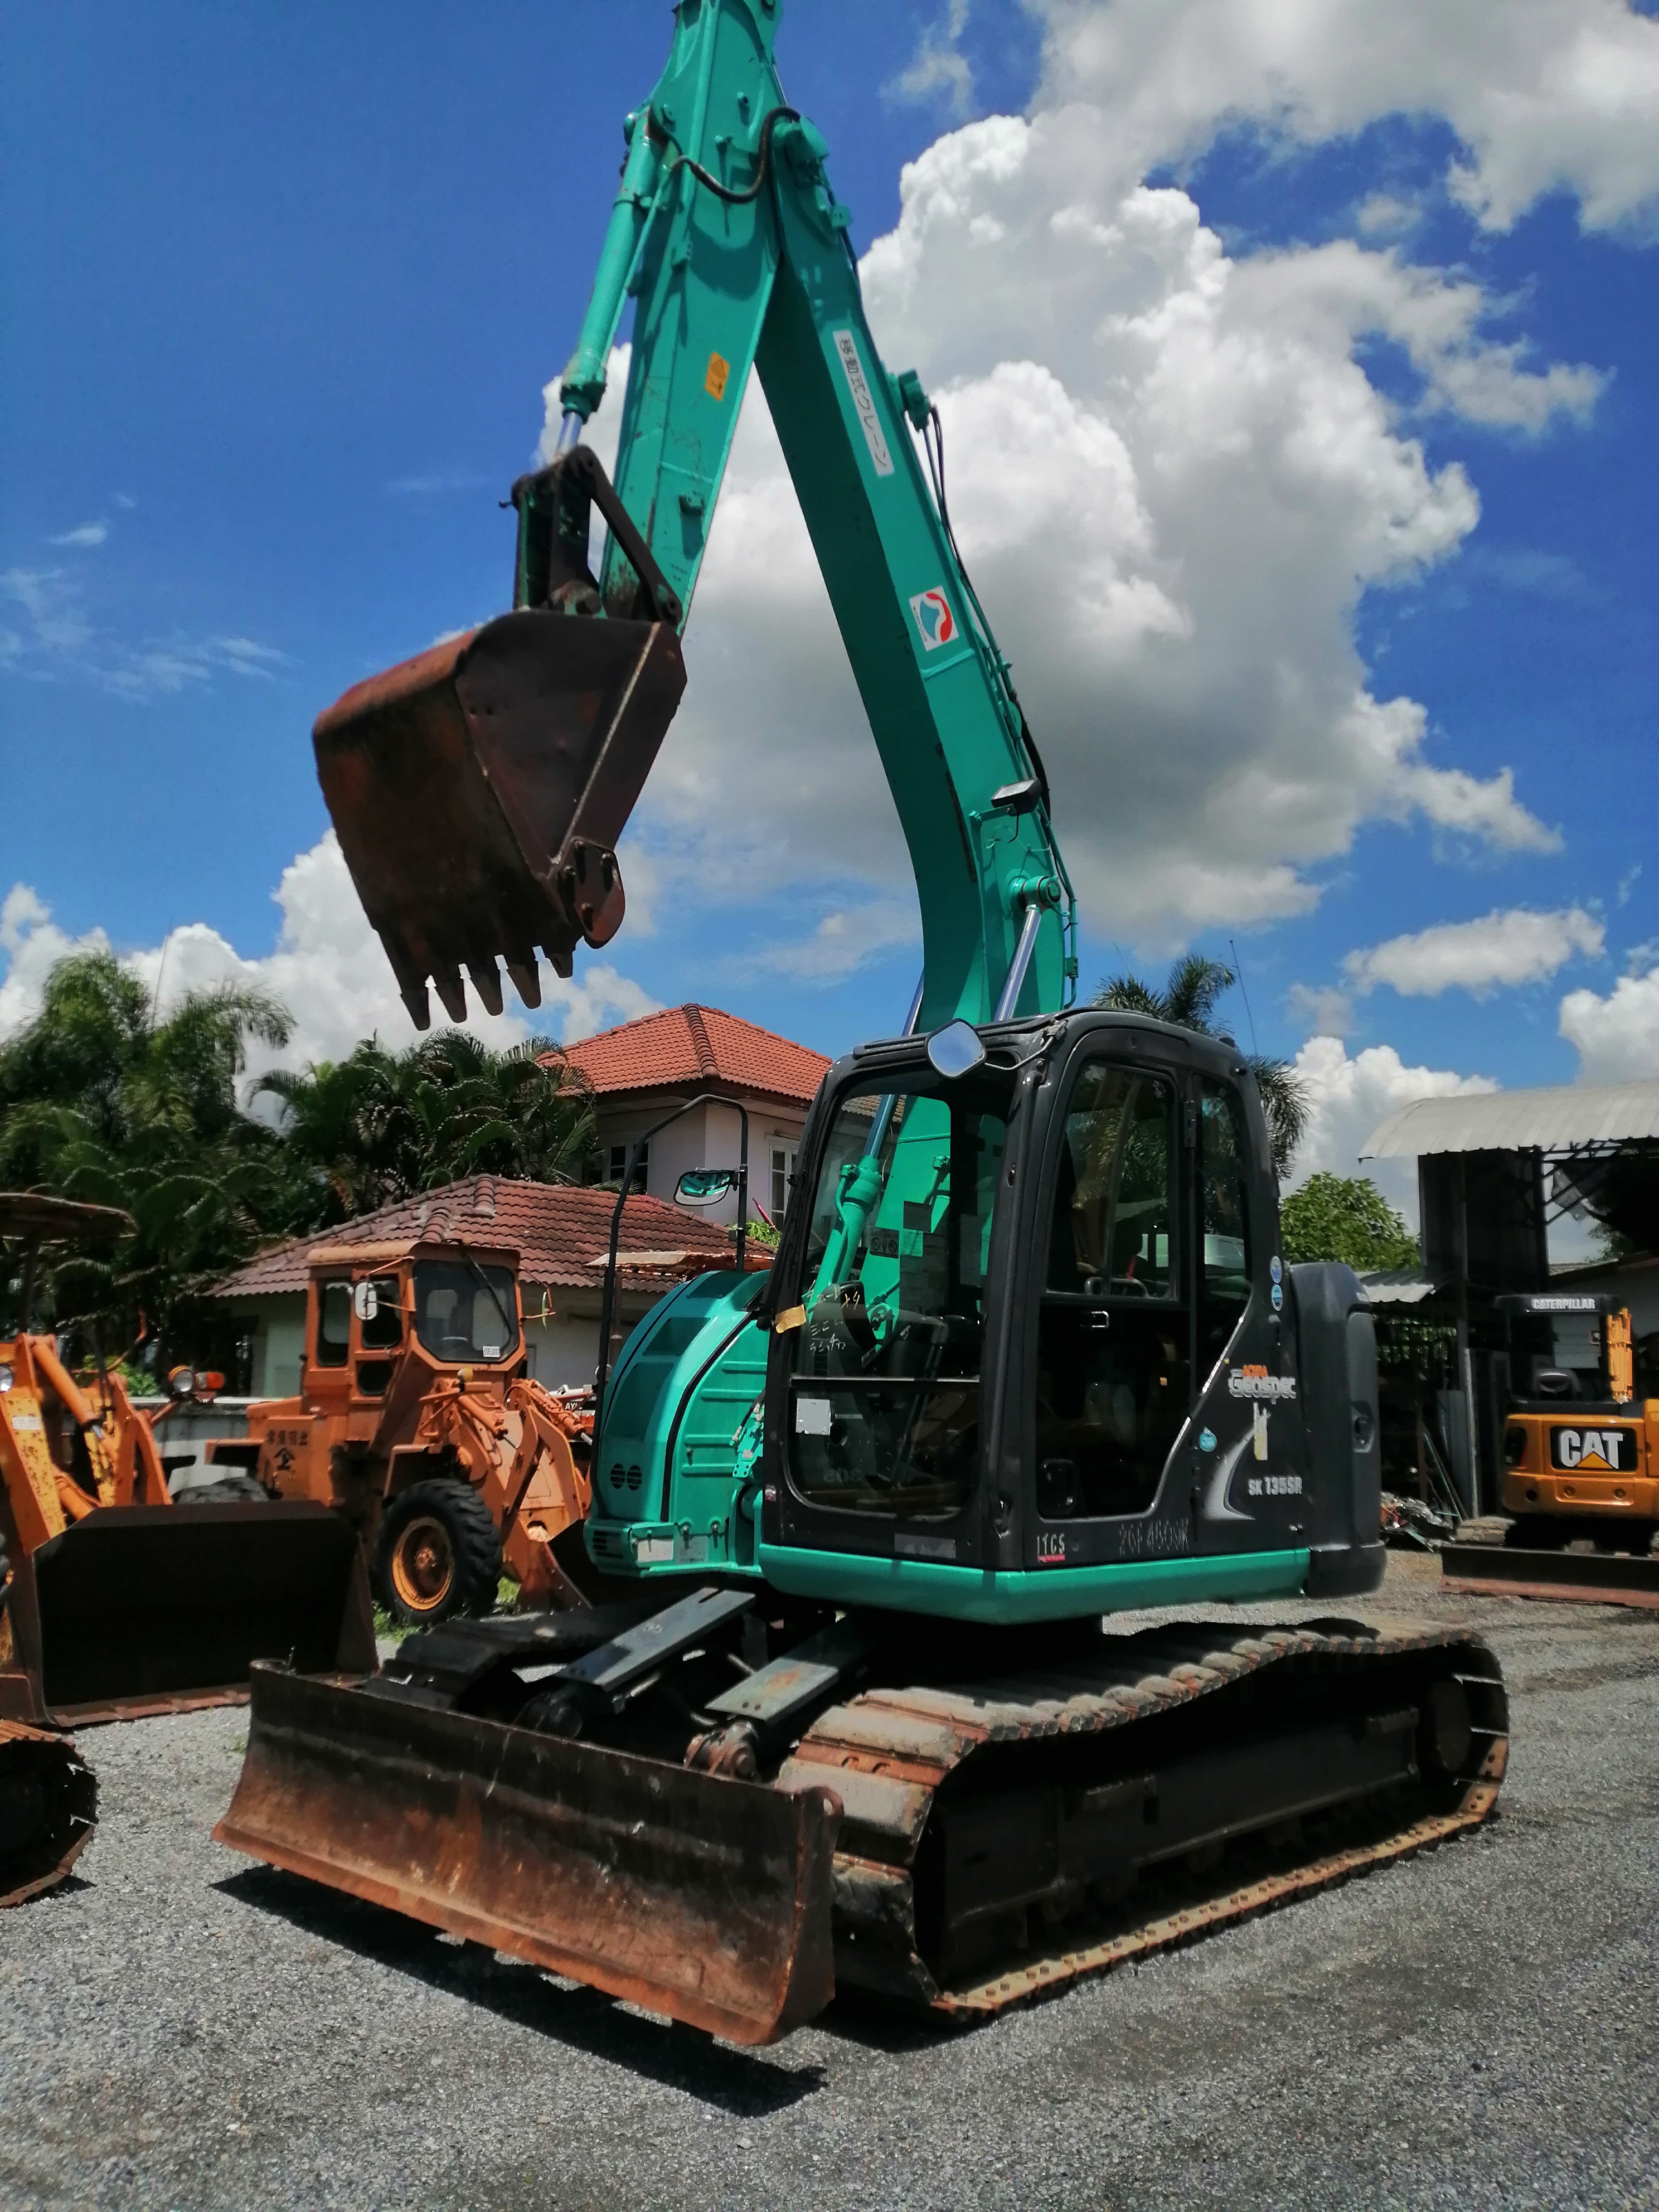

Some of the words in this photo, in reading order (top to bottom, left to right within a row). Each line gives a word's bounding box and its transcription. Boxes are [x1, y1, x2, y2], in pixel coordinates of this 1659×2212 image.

[1531, 1298, 1595, 1310] CATERPILLAR
[1228, 1369, 1297, 1405] Geospec
[1559, 1430, 1623, 1469] CAT
[1248, 1478, 1263, 1496] SK
[1264, 1476, 1303, 1495] 135SR
